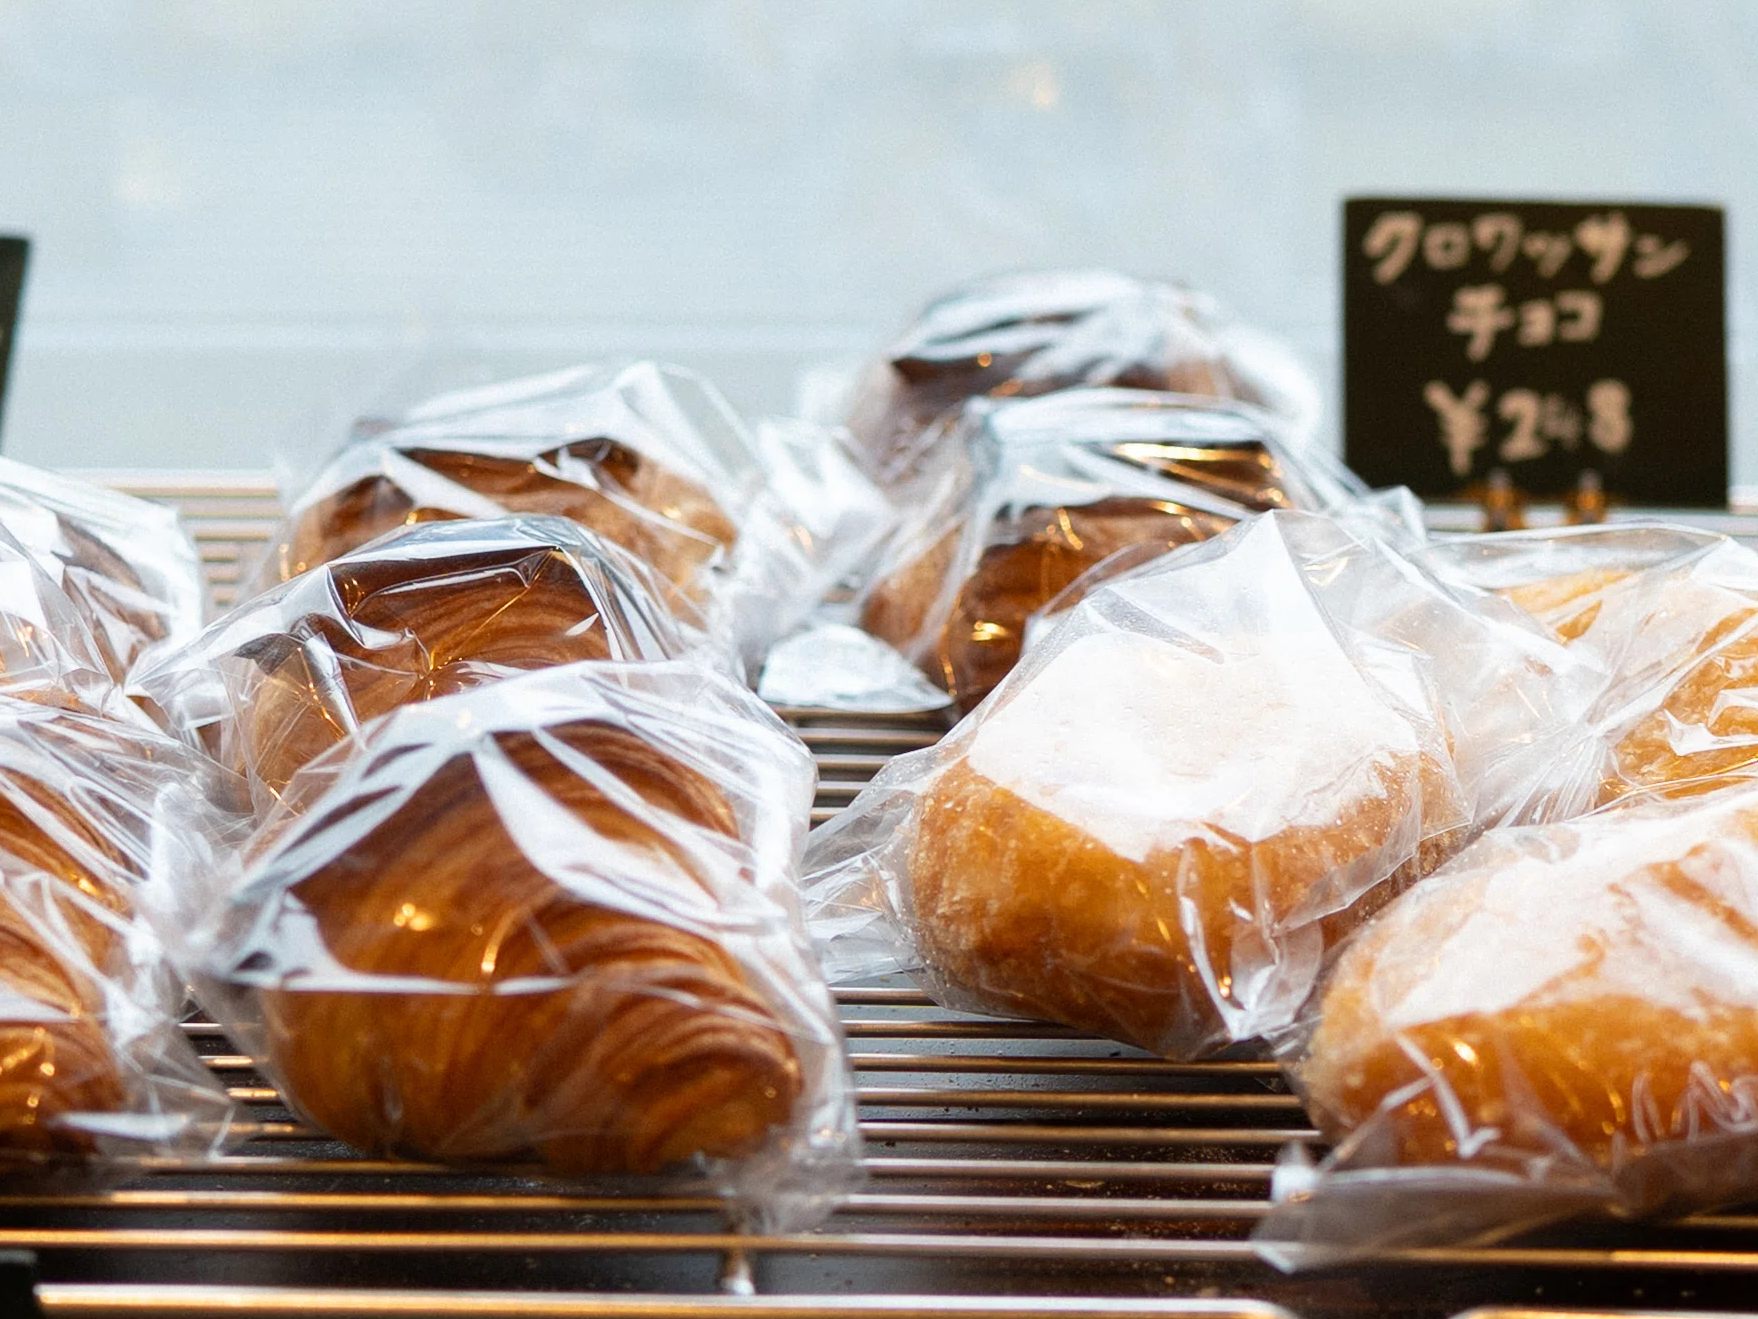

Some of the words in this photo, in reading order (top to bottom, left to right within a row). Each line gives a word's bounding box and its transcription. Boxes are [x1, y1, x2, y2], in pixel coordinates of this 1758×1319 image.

[1363, 212, 1690, 283] クロワッサン
[1447, 284, 1602, 361] チョコ
